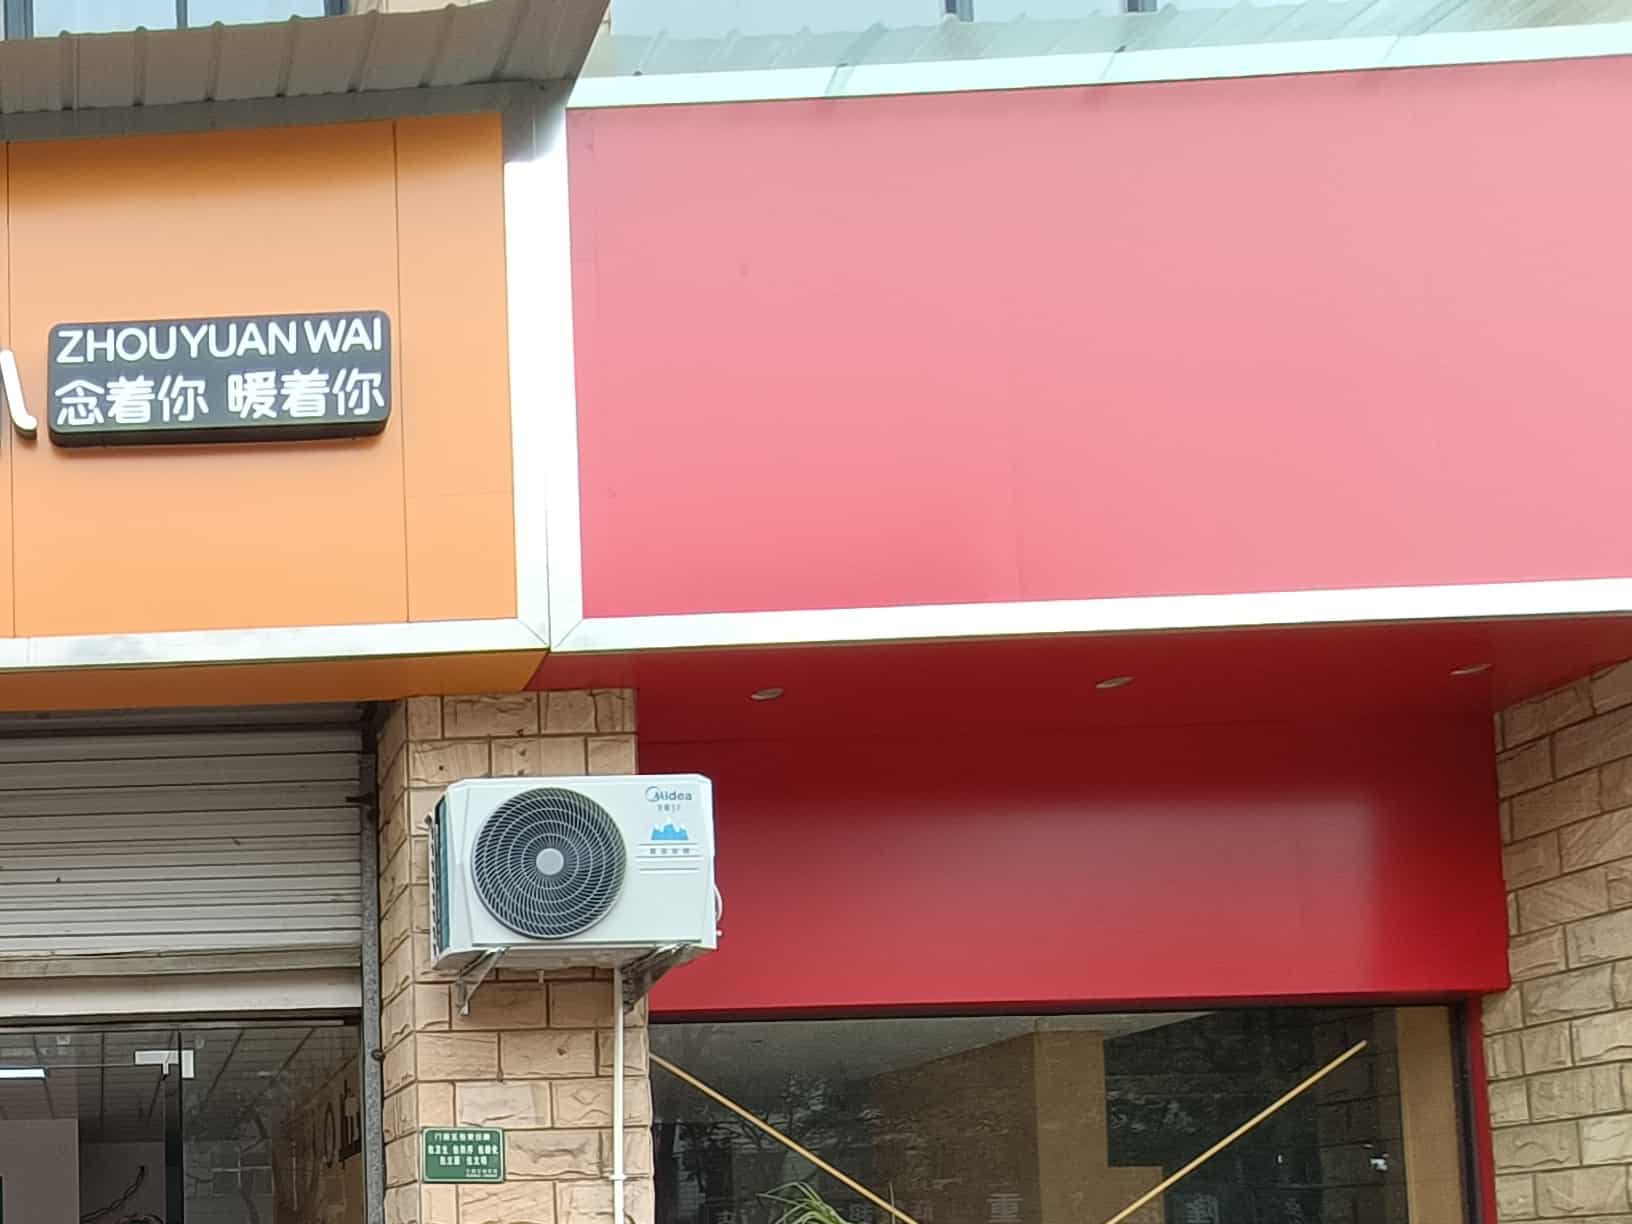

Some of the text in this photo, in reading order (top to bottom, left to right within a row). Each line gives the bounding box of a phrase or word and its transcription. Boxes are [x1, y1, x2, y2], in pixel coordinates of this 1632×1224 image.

[56, 317, 382, 363] ZHOUYUAN WAI
[55, 367, 384, 425] 念着你 暖着你
[648, 787, 692, 801] Midea
